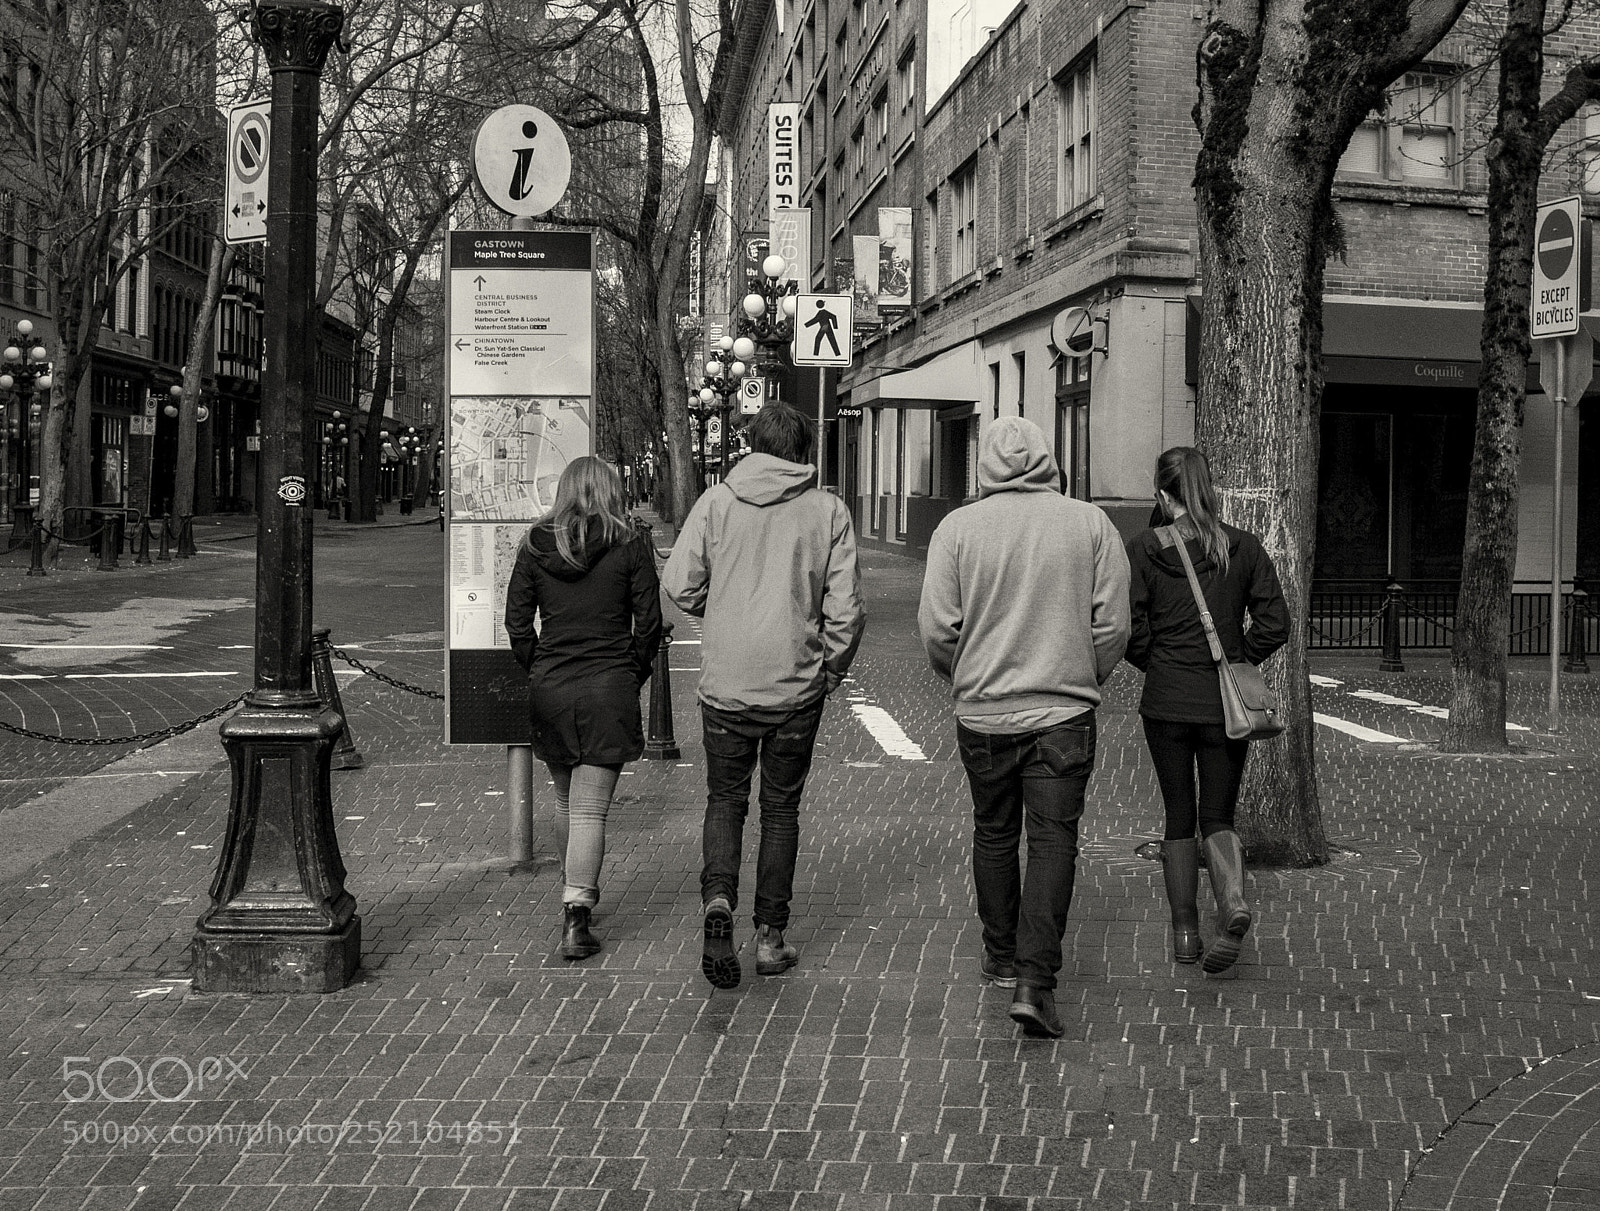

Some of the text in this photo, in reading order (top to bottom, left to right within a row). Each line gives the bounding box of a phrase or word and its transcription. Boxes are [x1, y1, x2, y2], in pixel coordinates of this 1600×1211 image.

[775, 115, 793, 187] SUITES
[474, 240, 525, 248] GASTOWN
[474, 251, 546, 260] Maple Tree Square
[1541, 286, 1570, 305] EXCEPT
[1536, 307, 1574, 326] BICYCLES
[1414, 363, 1465, 381] Coquille
